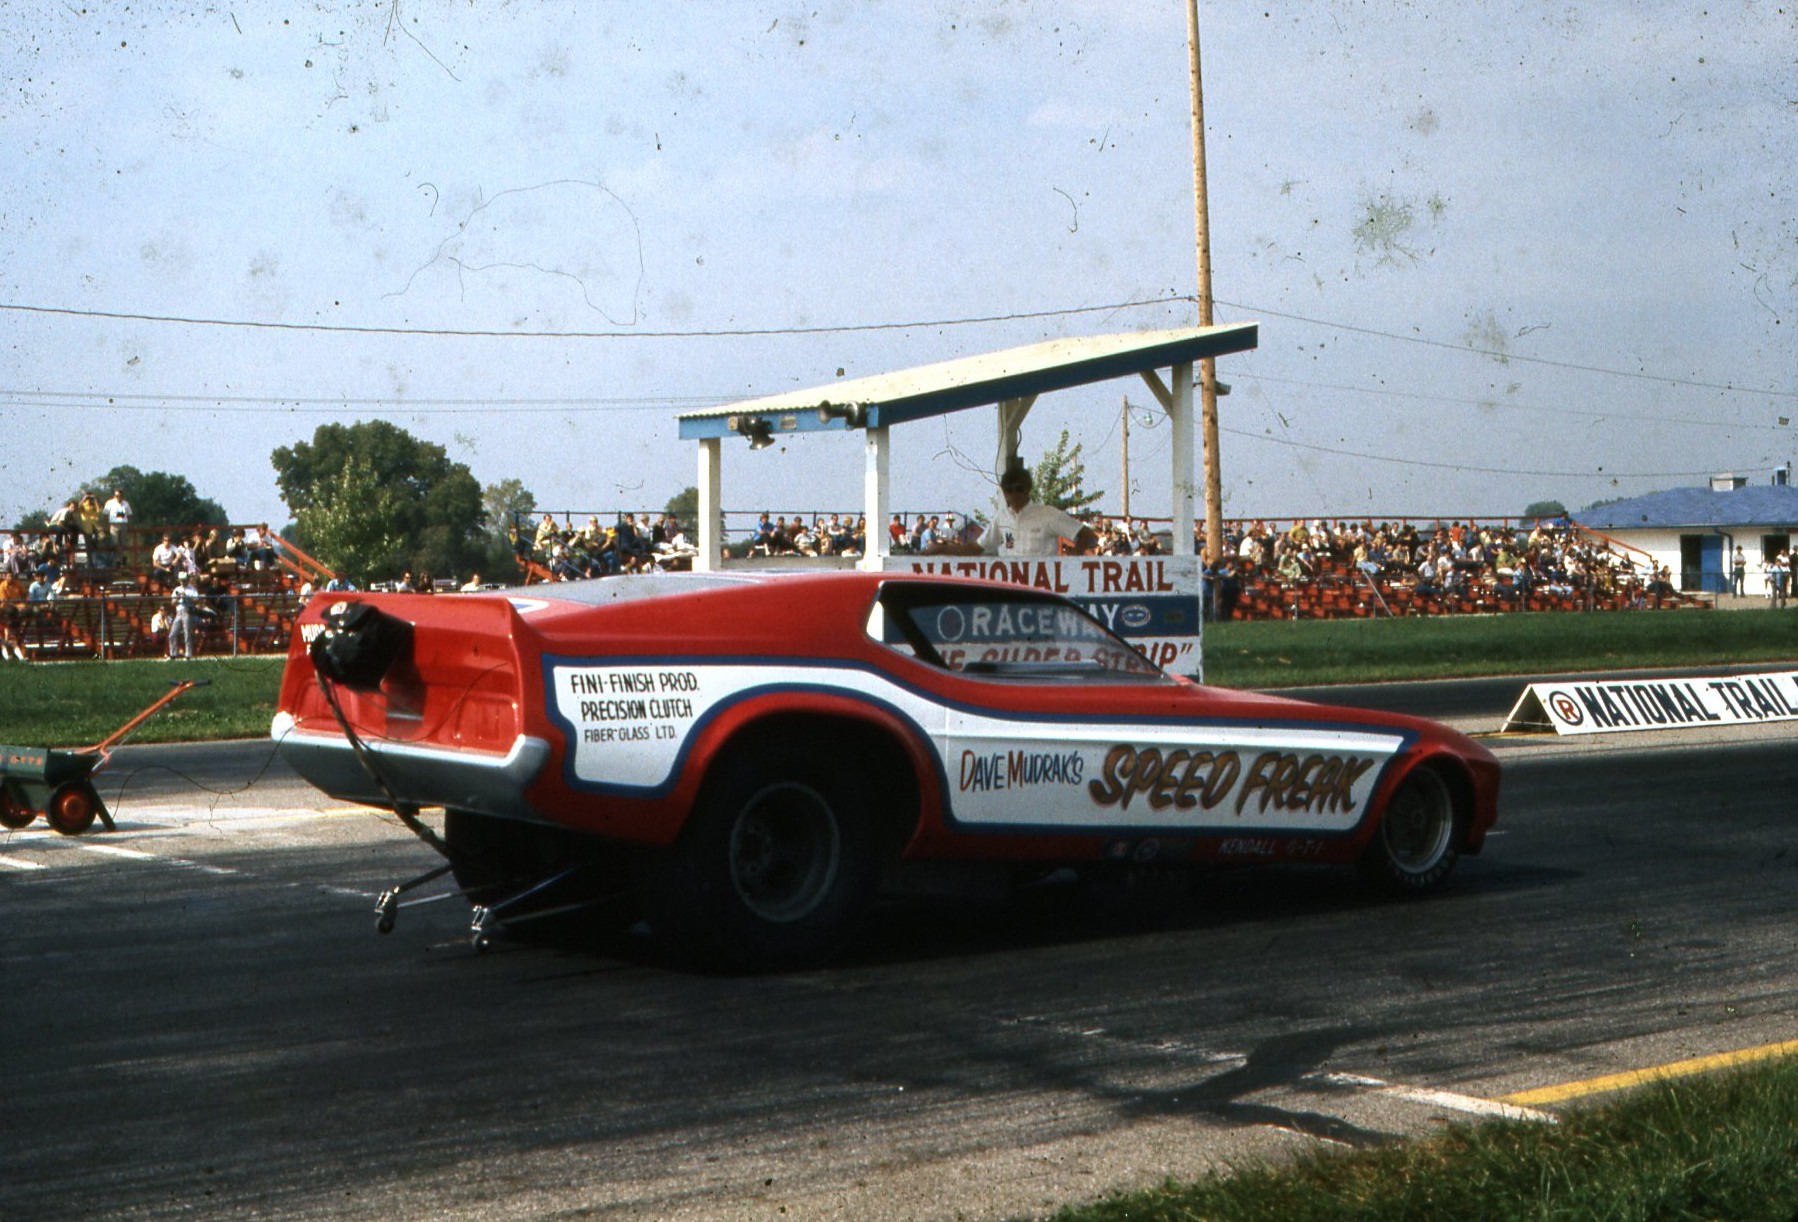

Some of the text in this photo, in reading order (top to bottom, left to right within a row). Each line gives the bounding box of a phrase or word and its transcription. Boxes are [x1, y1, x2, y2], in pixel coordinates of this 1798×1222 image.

[1081, 561, 1173, 593] TRAIL
[570, 672, 700, 694] FINI-FINISH PROD.
[581, 698, 693, 722] PRECISION CLUTCH
[1574, 683, 1721, 728] NATIONAL
[1707, 678, 1798, 719] TRAIL
[960, 749, 1084, 793] DAVE MUDRAK'S
[1089, 744, 1375, 816] SPEED FREAK
[1217, 838, 1278, 856] KENDALL
